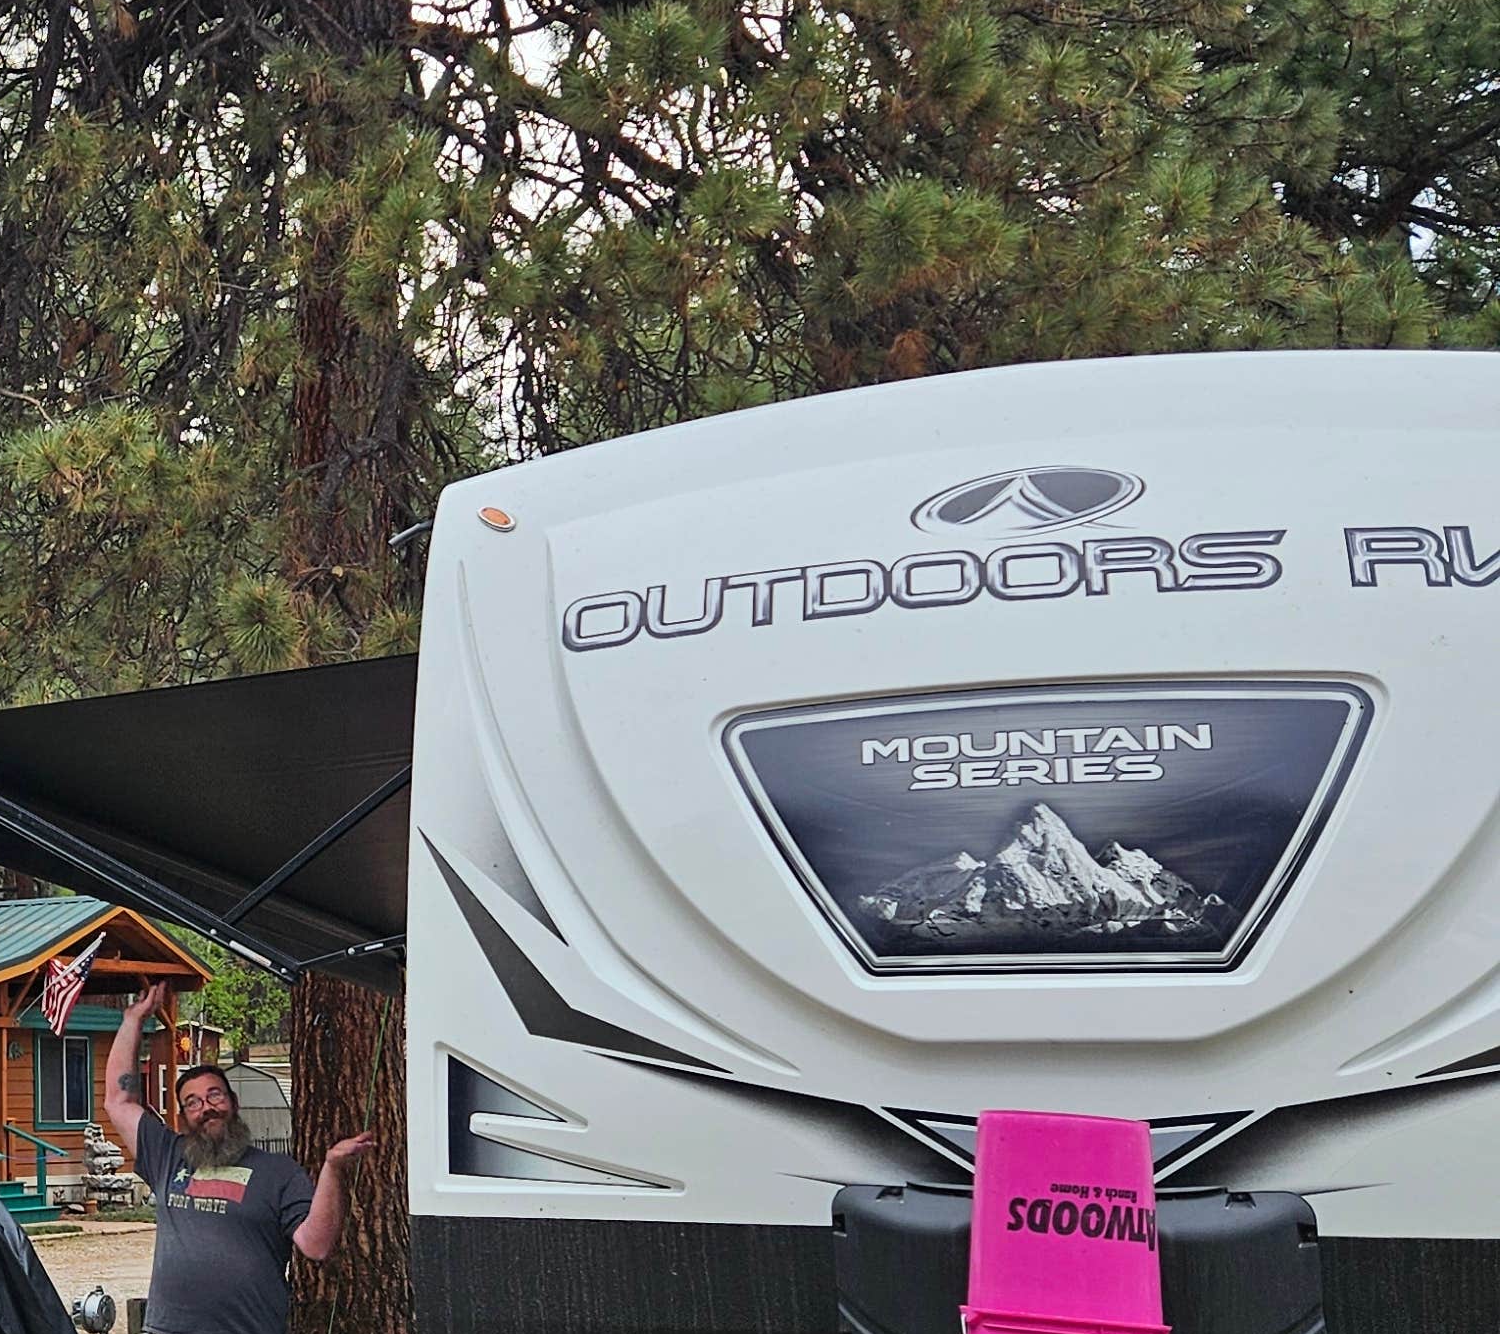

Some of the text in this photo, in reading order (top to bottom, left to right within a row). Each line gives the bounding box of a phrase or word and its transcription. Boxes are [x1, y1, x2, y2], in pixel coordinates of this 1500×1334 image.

[561, 528, 1288, 653] OUTDOORS
[860, 723, 1213, 765] MOUNTAIN
[908, 753, 1165, 791] SERIES
[167, 1193, 228, 1214] FORT WORTH
[1050, 1183, 1137, 1203] Ranch & Home
[1006, 1197, 1156, 1252] ATWOODS
